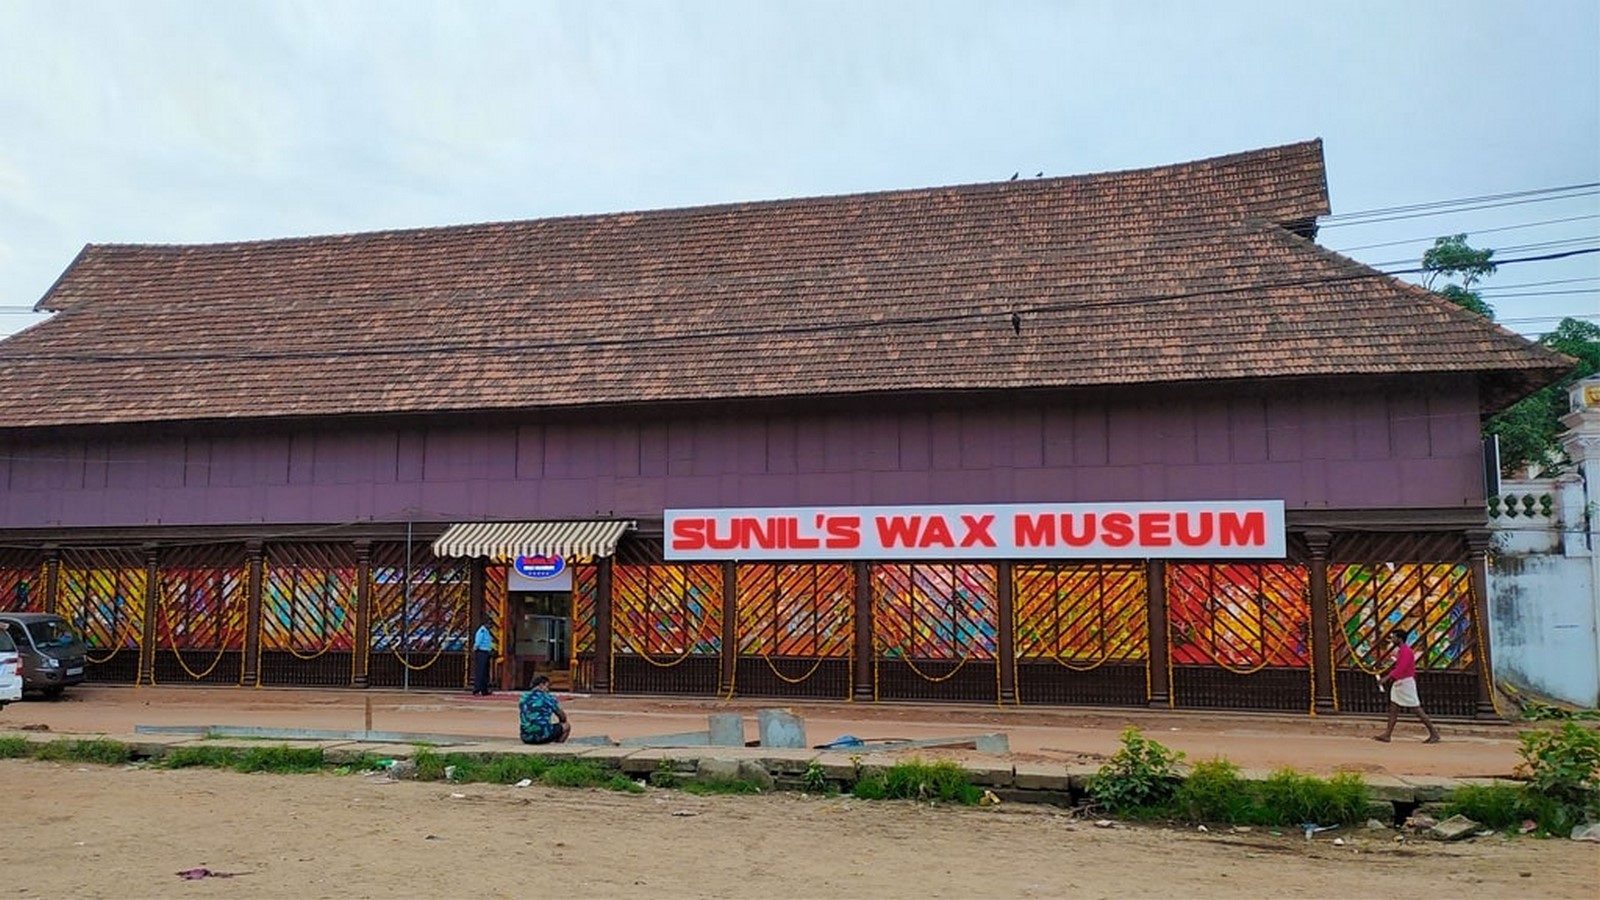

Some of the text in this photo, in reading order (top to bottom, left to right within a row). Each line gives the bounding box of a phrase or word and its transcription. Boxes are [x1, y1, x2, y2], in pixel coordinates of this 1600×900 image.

[672, 512, 1266, 550] SUNIL'S WAX MUSEUM
